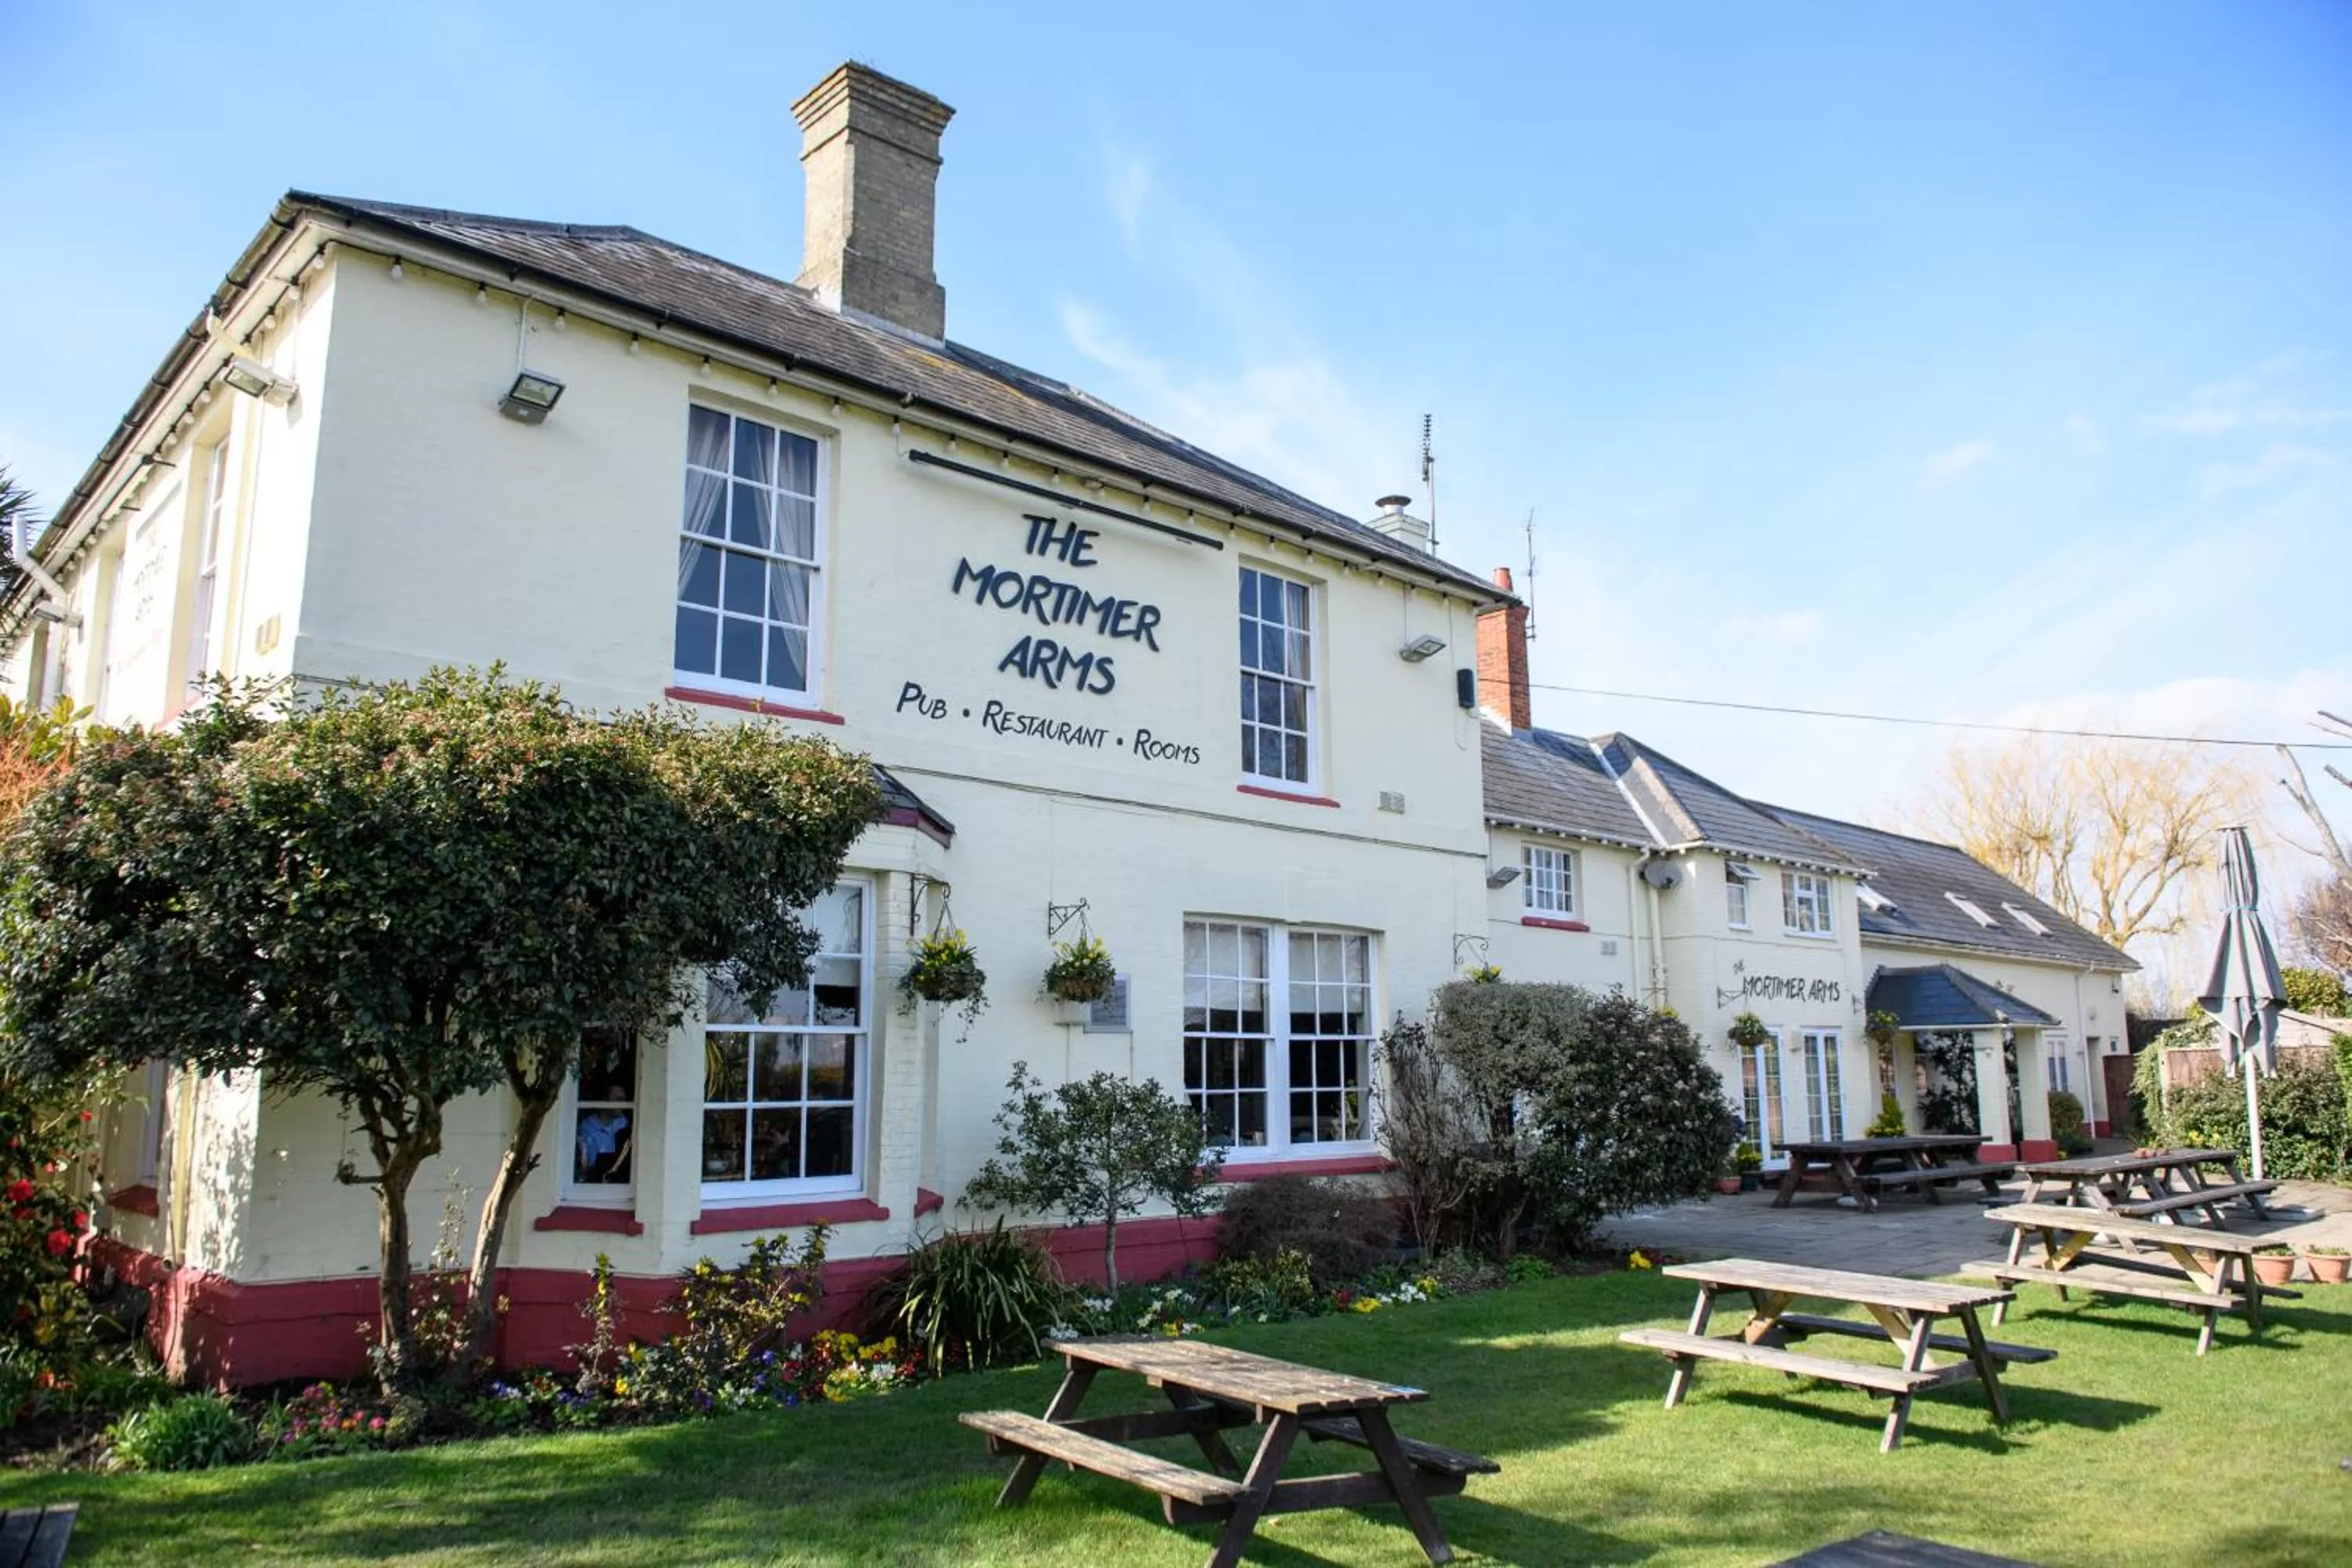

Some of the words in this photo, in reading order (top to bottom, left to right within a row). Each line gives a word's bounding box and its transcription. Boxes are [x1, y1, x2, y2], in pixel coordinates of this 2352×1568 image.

[1022, 513, 1101, 568] THE
[951, 557, 1161, 653] MORTIMER
[998, 634, 1116, 695] ARMS
[896, 681, 948, 720] PUB
[982, 699, 1109, 748] RESTAURANT
[1134, 728, 1201, 765] ROOMS
[1743, 975, 1806, 1004] MORTIMER
[1808, 978, 1841, 1004] ARMS
